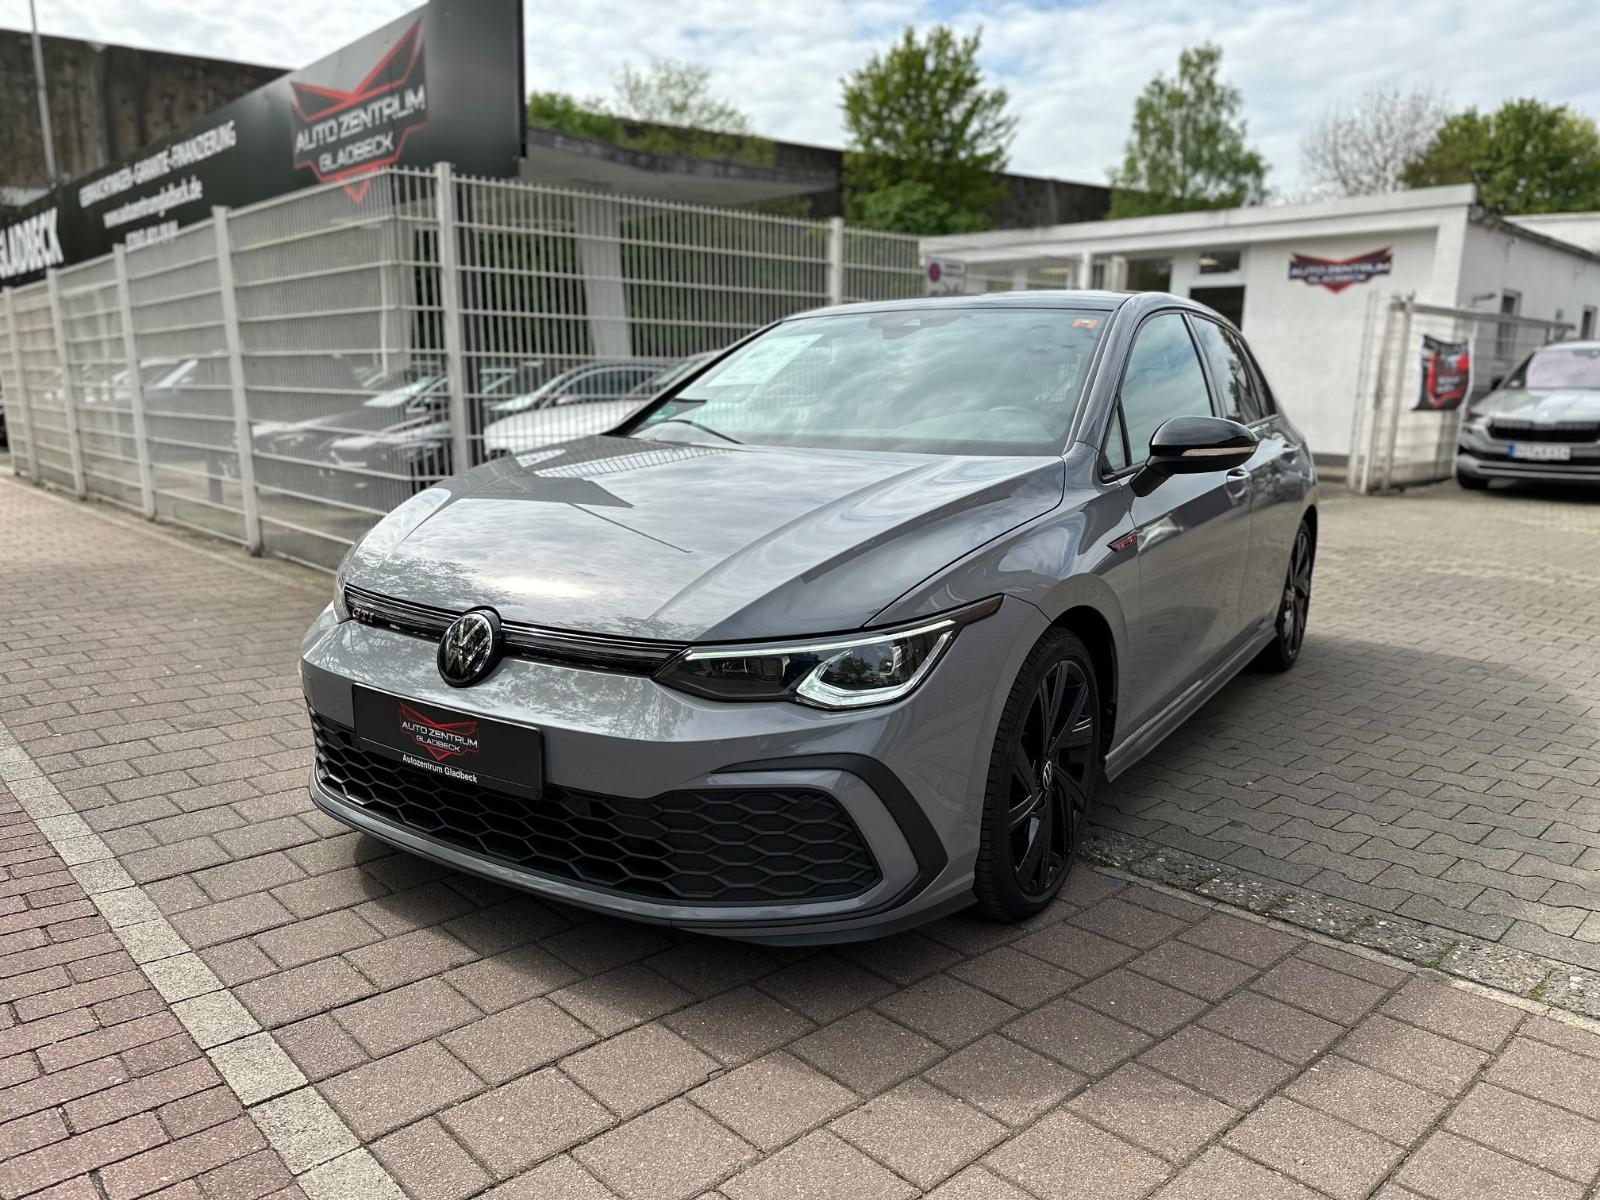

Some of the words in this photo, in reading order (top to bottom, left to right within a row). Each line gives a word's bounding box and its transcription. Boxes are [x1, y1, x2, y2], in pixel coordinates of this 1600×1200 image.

[294, 117, 339, 154] AUTO
[338, 84, 426, 139] ZENTRUM
[318, 130, 394, 173] GLADBECK
[401, 720, 428, 735] AUTO
[428, 727, 478, 748] ZENTRUM
[415, 734, 460, 753] GLADBECK
[402, 753, 443, 774] Autozentrum
[444, 766, 478, 783] Gladbeck
